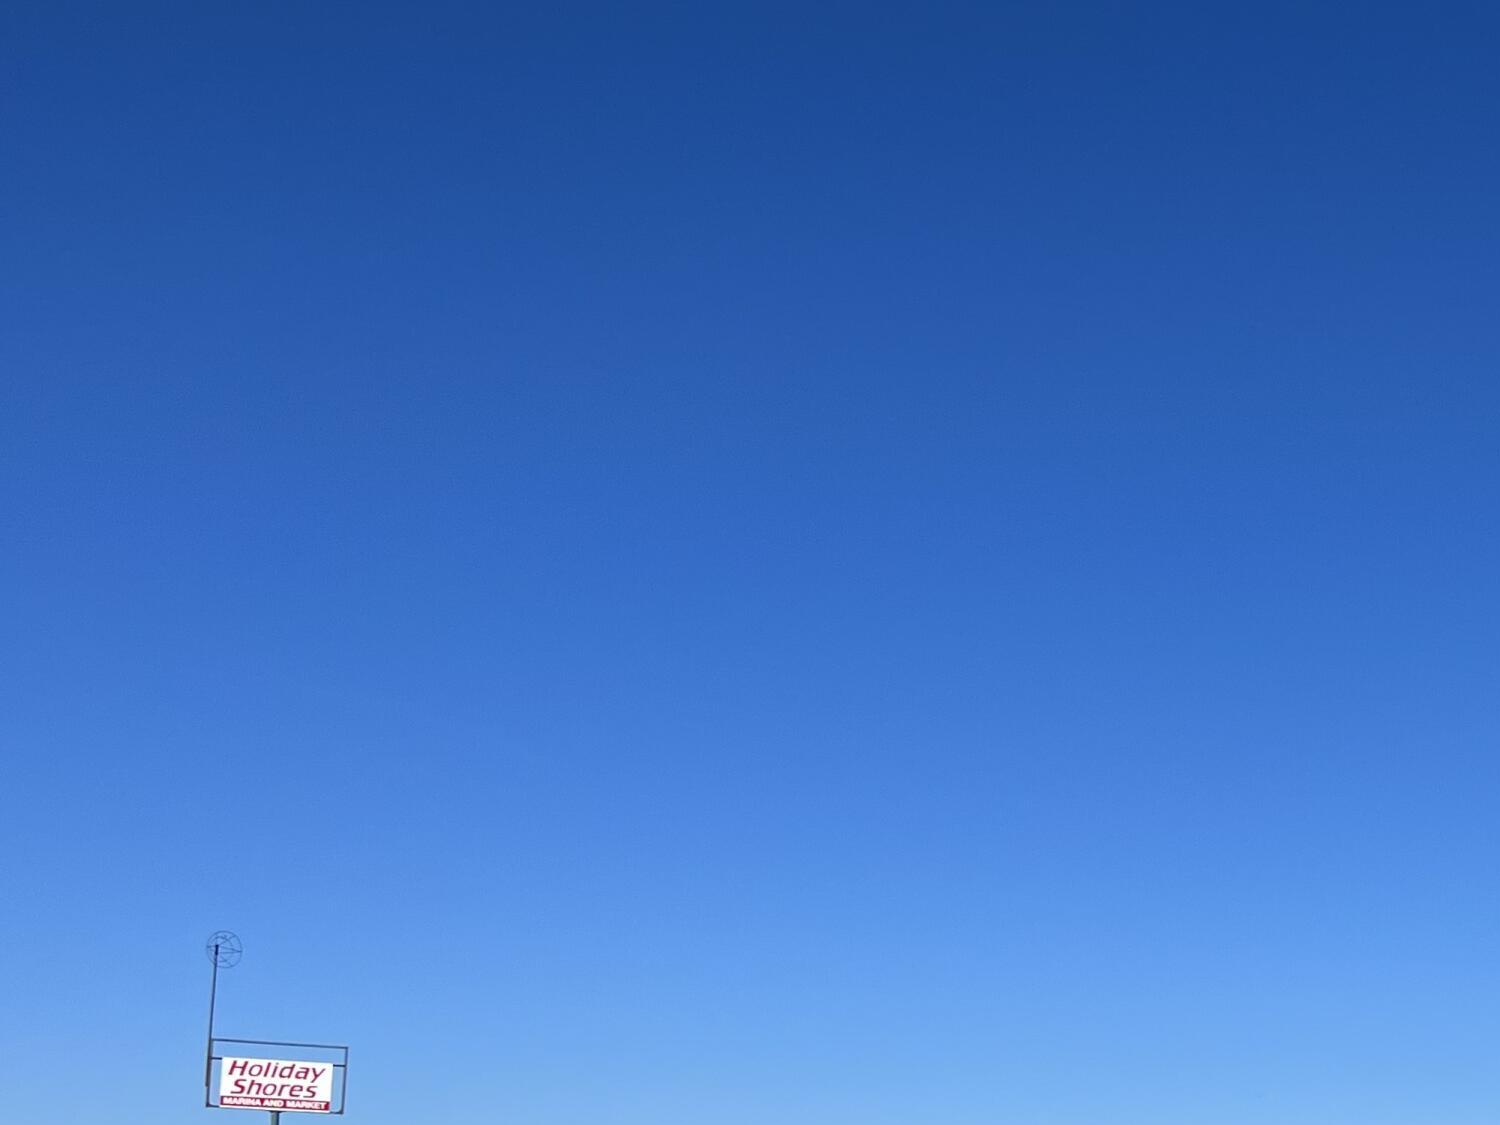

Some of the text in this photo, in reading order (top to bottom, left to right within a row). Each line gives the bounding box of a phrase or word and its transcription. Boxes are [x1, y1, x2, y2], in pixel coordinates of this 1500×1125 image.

[228, 1060, 326, 1083] Holiday
[230, 1079, 318, 1098] Shores
[223, 1097, 327, 1110] MARINA AND MARKET
